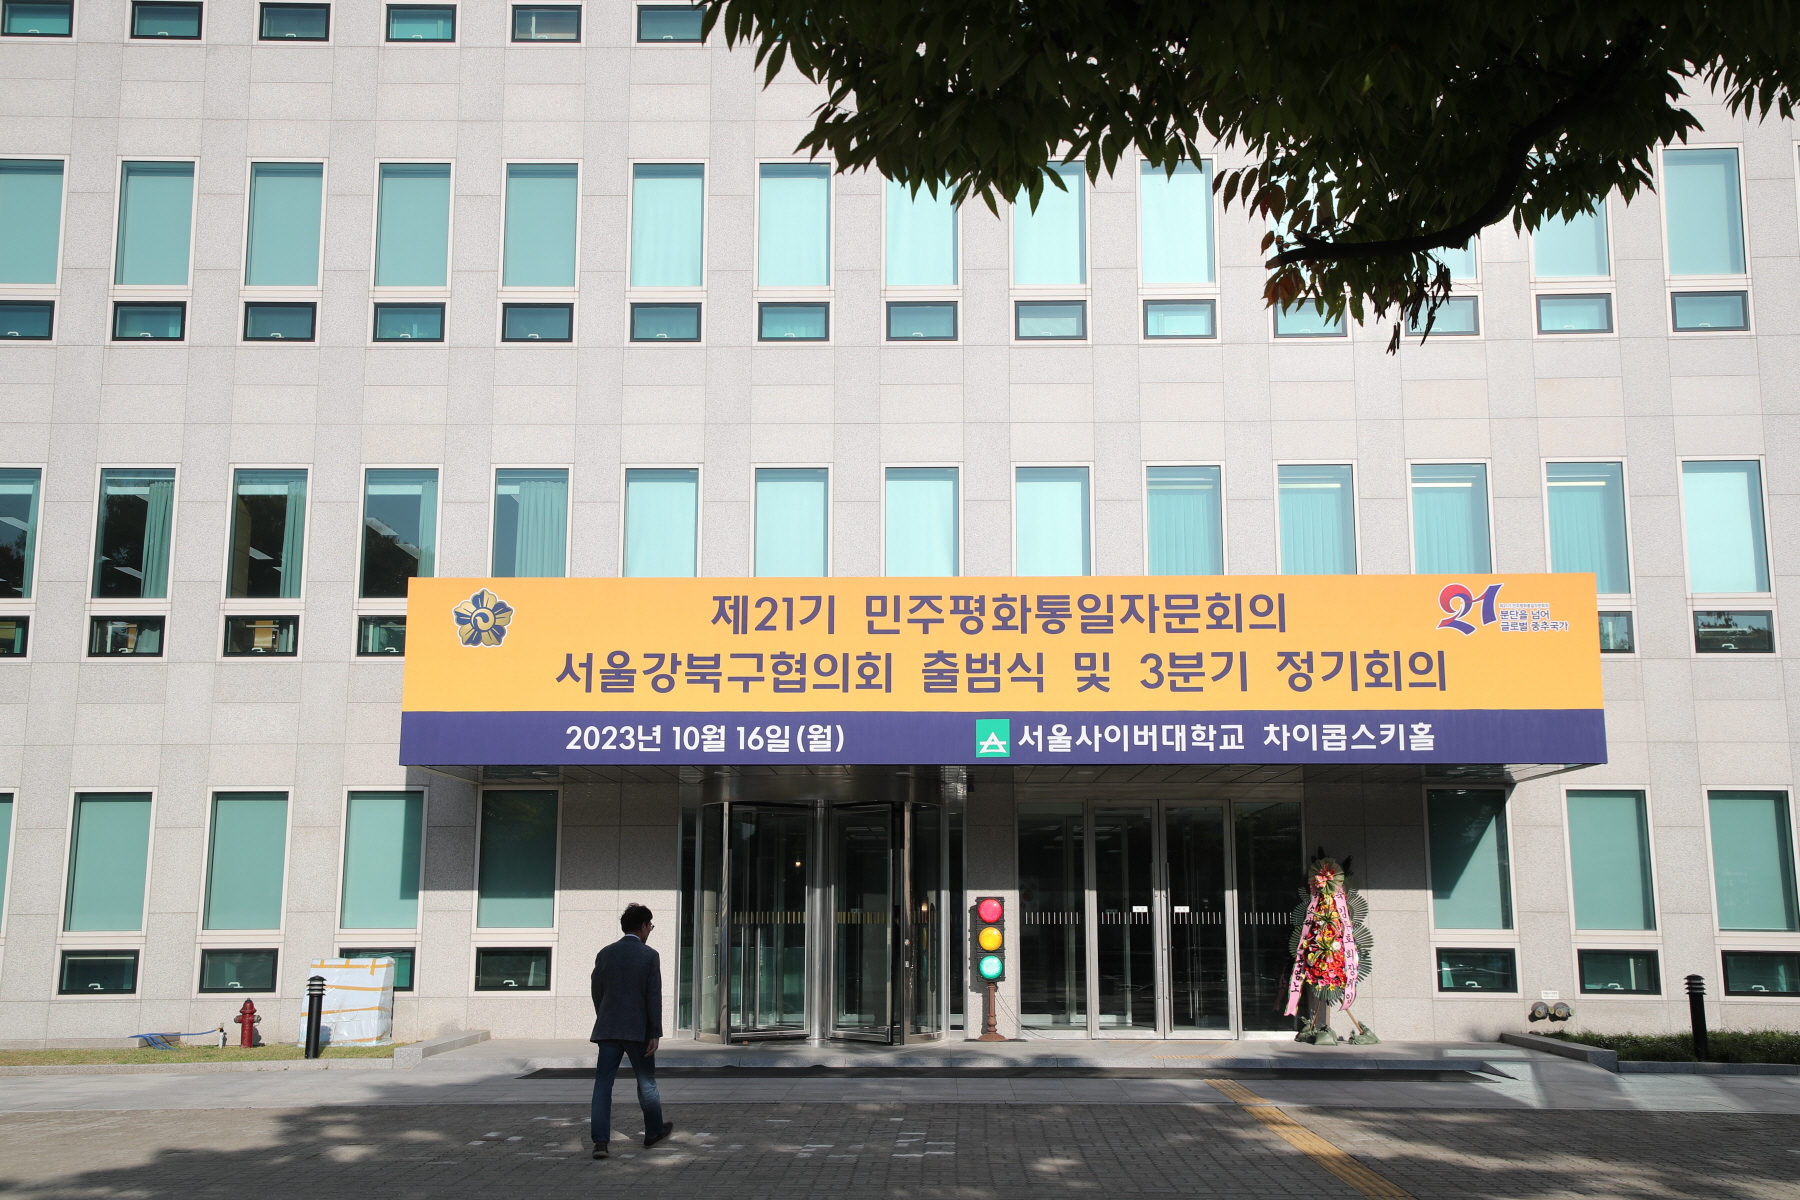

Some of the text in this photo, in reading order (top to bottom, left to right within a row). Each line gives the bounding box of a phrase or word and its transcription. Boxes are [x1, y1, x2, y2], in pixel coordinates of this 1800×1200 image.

[712, 593, 1285, 635] 제21기 민주평화통일자문회의
[1500, 609, 1550, 620] 분단을 넘어
[1500, 621, 1568, 631] 글로벌 중추국가
[556, 650, 1446, 693] 서울강북구협의회 출범식 및 3분기 정기회의
[566, 725, 661, 752] 2023년
[673, 725, 725, 752] 10월
[1018, 722, 1435, 753] 서울사이버대학교 차이콥스키홀
